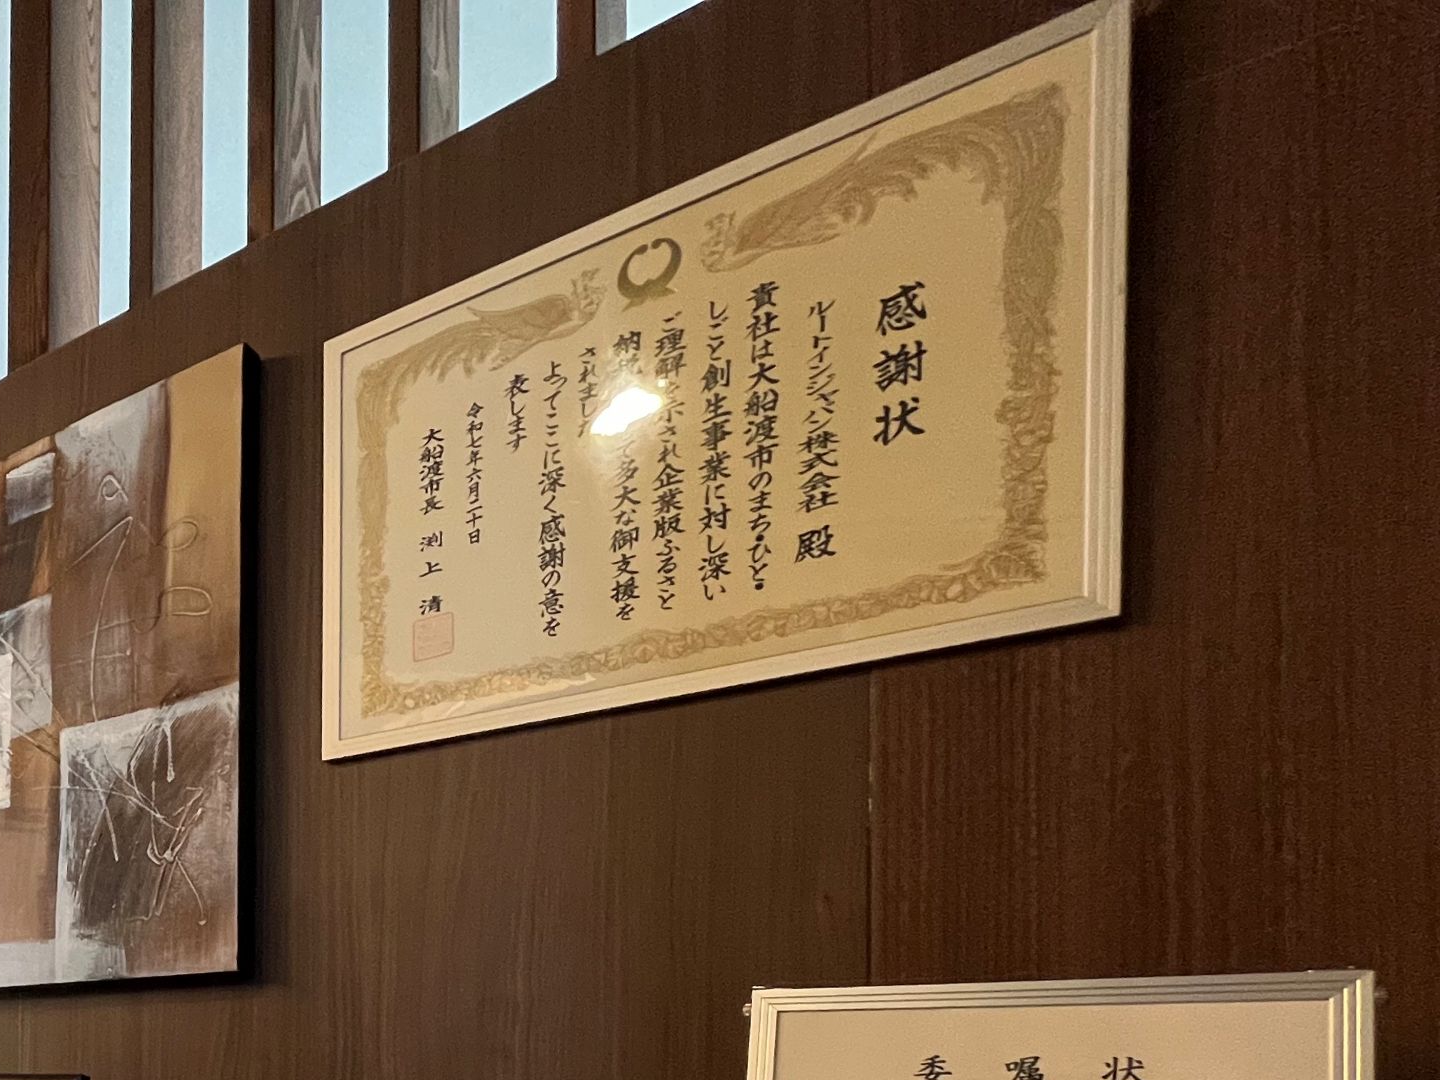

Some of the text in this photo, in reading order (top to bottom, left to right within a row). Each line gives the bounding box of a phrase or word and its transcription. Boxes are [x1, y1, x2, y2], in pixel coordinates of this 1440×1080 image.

[504, 374, 530, 452] 表します
[795, 300, 840, 563] ルートインジャパン株式会社 殿
[873, 281, 927, 446] 感謝状
[419, 428, 444, 515] 大船渡市長
[466, 402, 484, 544] 令和七年六月二十日
[538, 361, 568, 636] よってここに深く感謝の意を
[698, 300, 732, 600] しごと創生事業に対し深い
